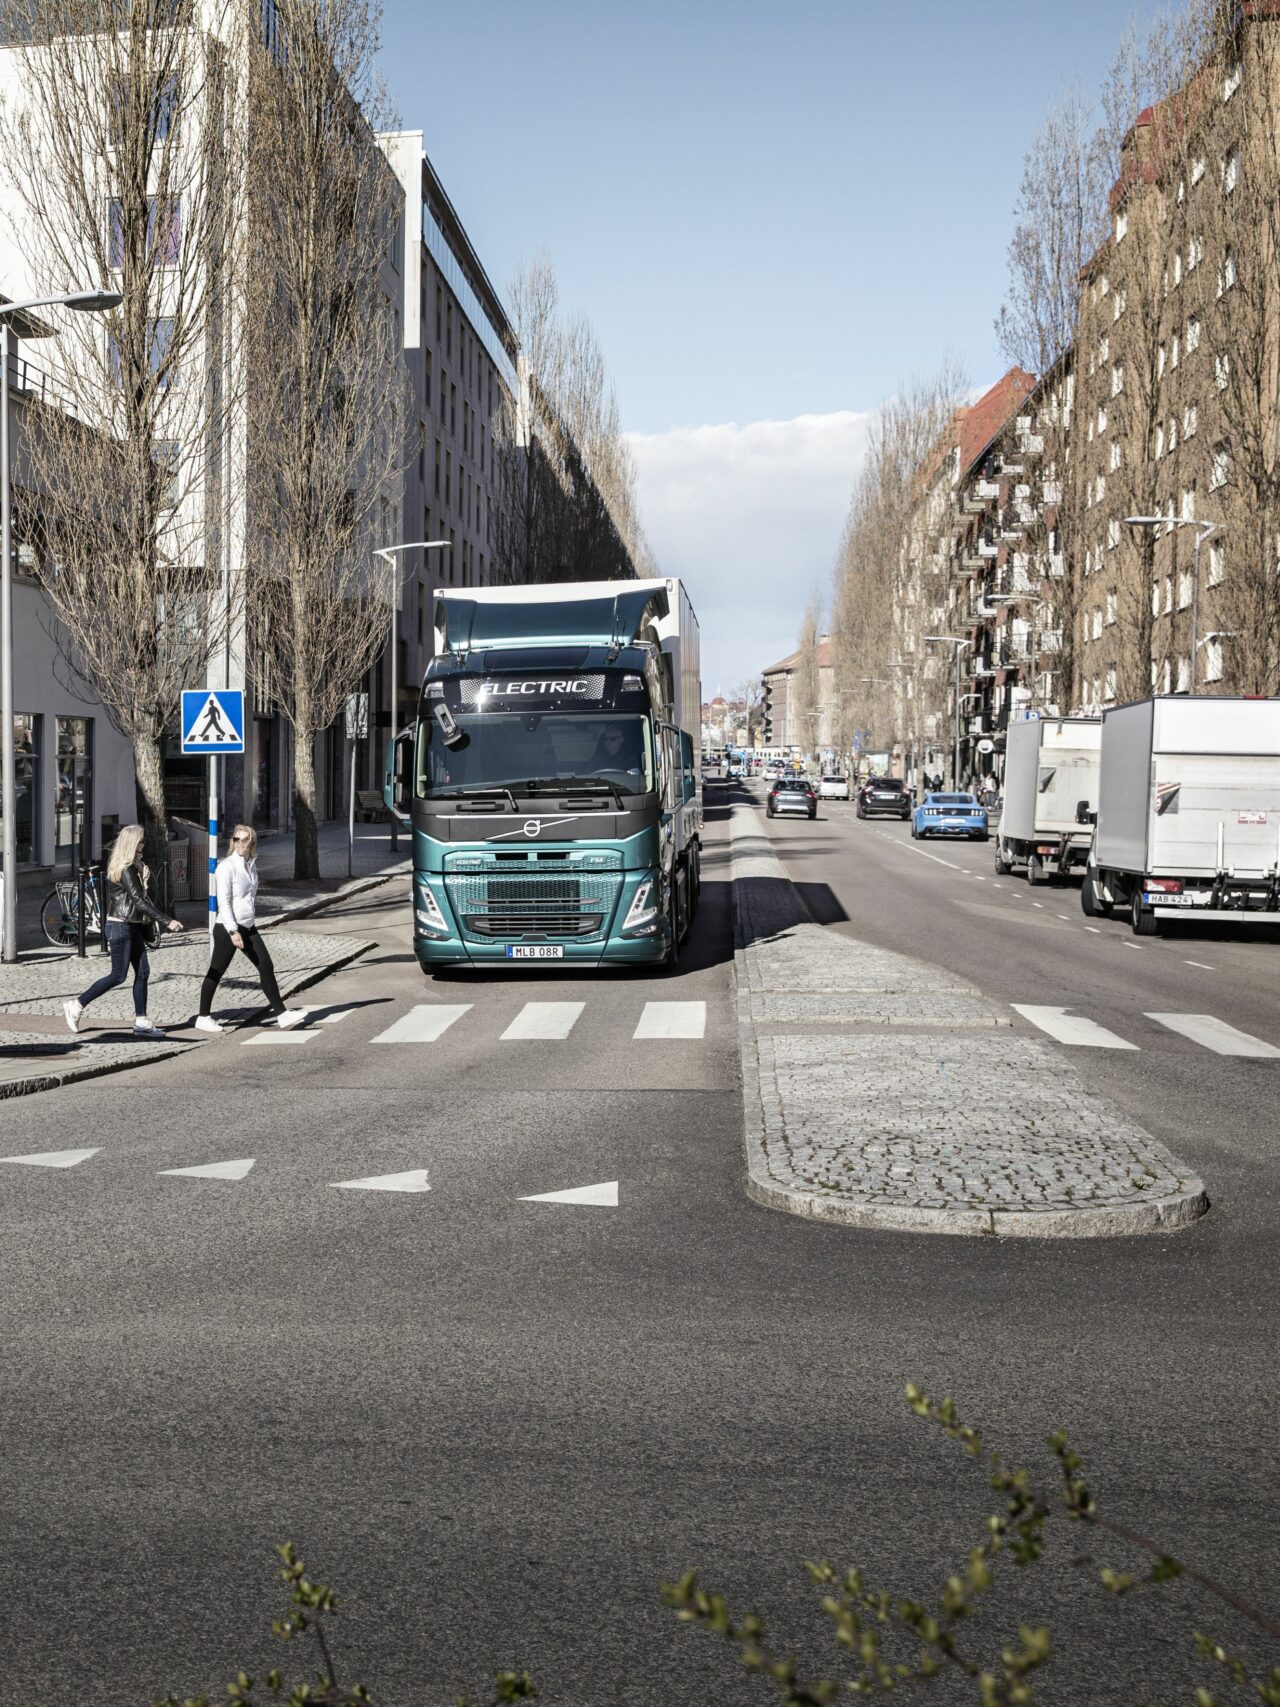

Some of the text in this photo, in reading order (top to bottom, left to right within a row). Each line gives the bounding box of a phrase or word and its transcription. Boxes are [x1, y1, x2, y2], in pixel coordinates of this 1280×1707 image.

[479, 680, 588, 696] ELECTRIC
[1151, 895, 1169, 903] HAB
[515, 947, 559, 957] MLB 08R
